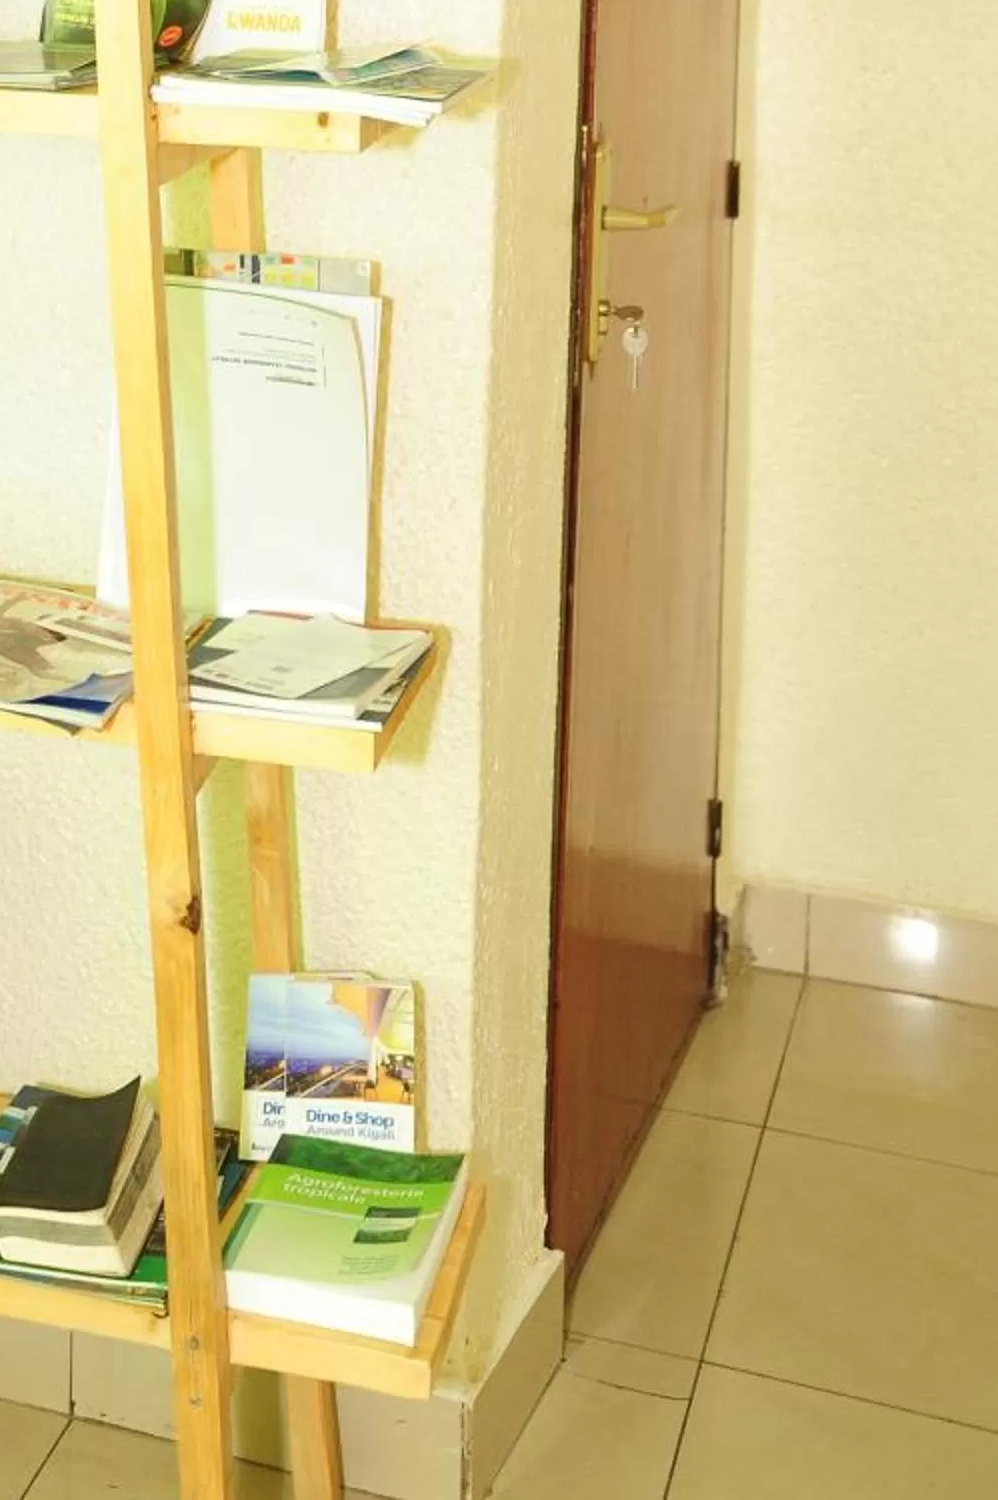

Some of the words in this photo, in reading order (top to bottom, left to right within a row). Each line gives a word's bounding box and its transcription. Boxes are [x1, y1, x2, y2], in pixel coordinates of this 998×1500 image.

[306, 1109, 341, 1123] Dine
[343, 1111, 353, 1124] &
[355, 1111, 395, 1131] Shop
